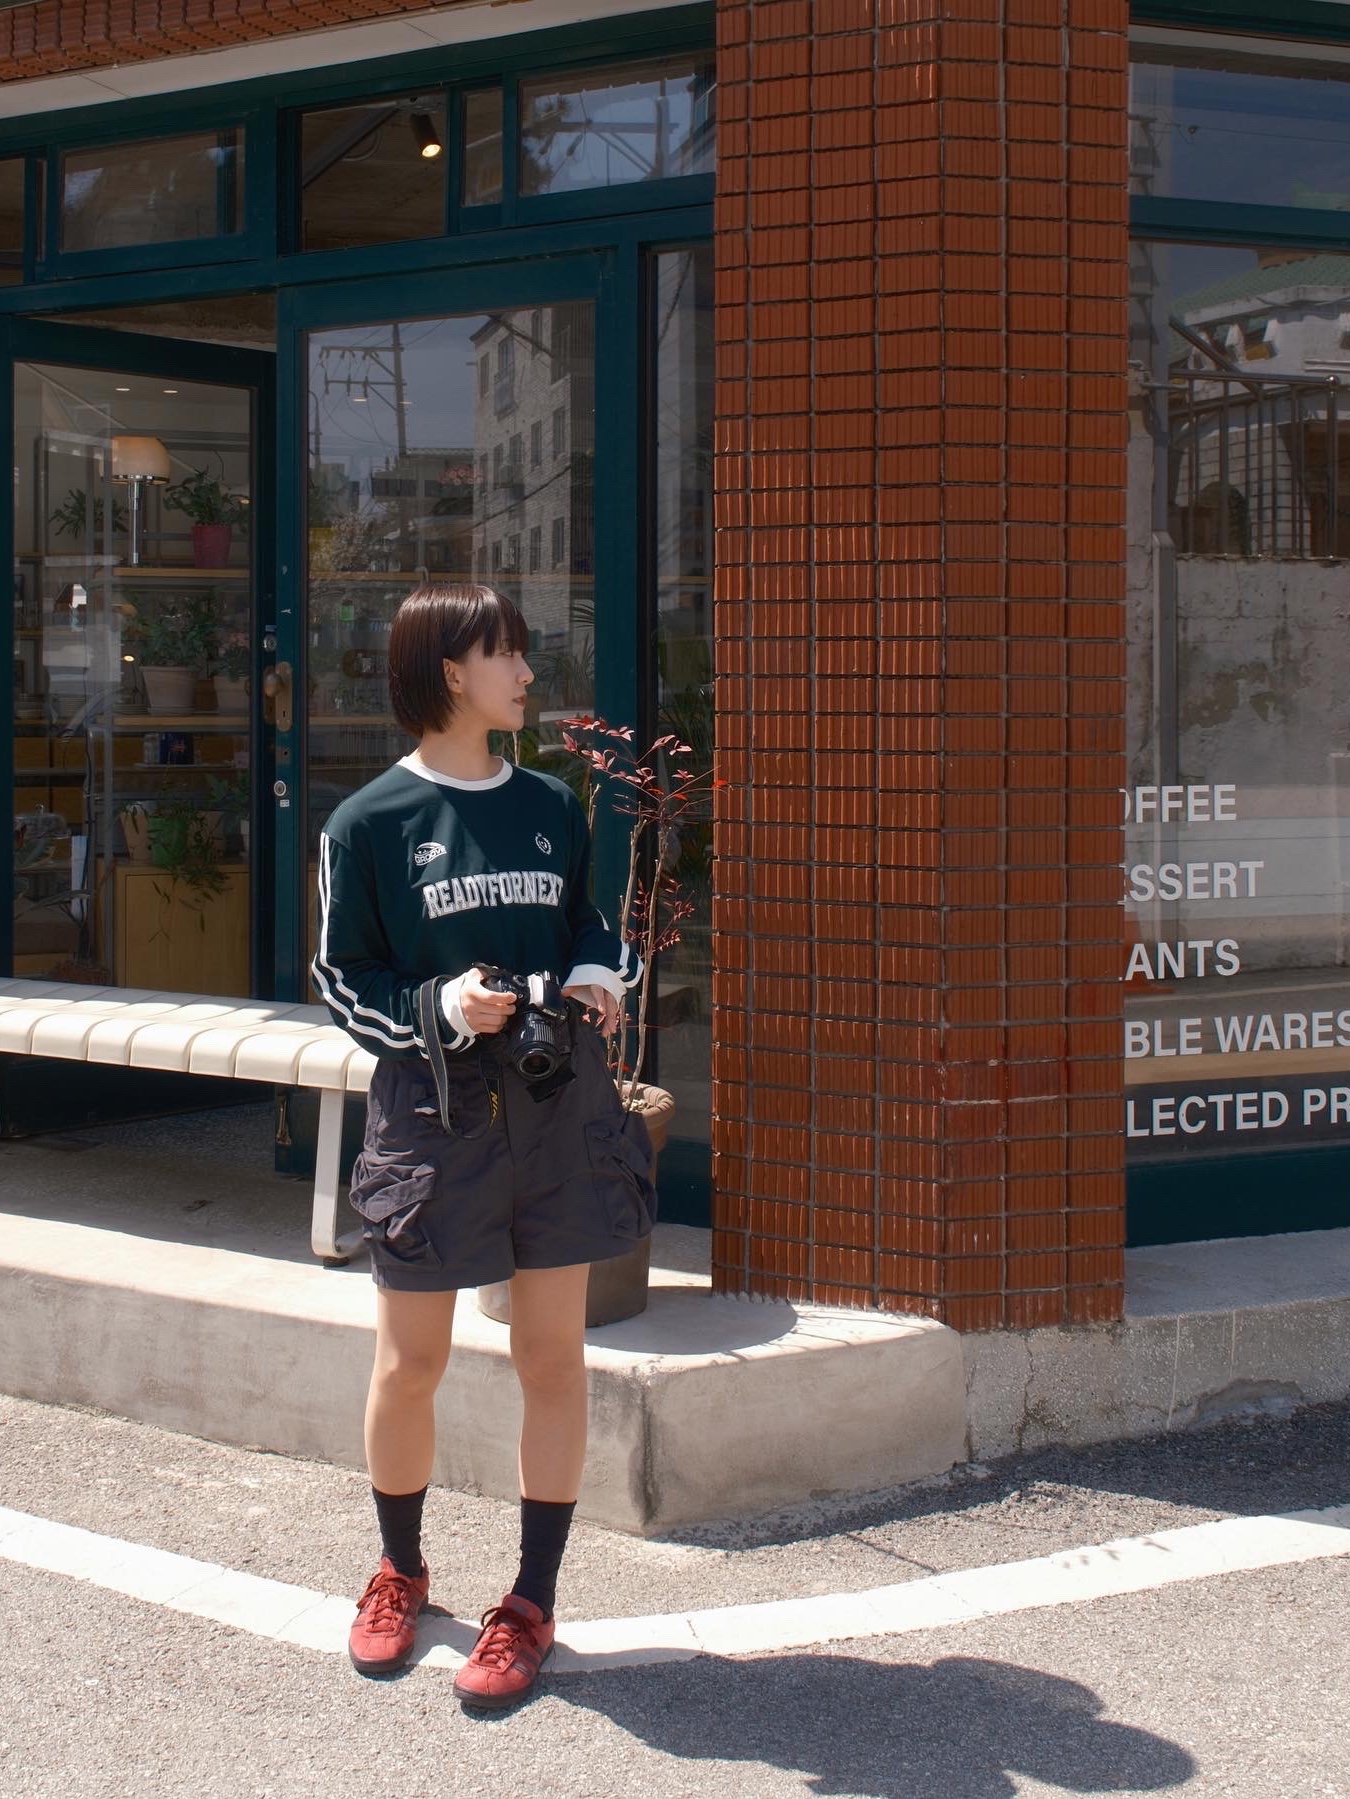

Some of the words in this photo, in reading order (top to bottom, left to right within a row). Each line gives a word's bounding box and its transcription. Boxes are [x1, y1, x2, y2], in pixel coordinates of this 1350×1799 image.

[1124, 860, 1264, 902] SSERT
[1125, 938, 1240, 981] ANTS
[1124, 1017, 1203, 1058] BLE
[1126, 1090, 1289, 1137] LECTED
